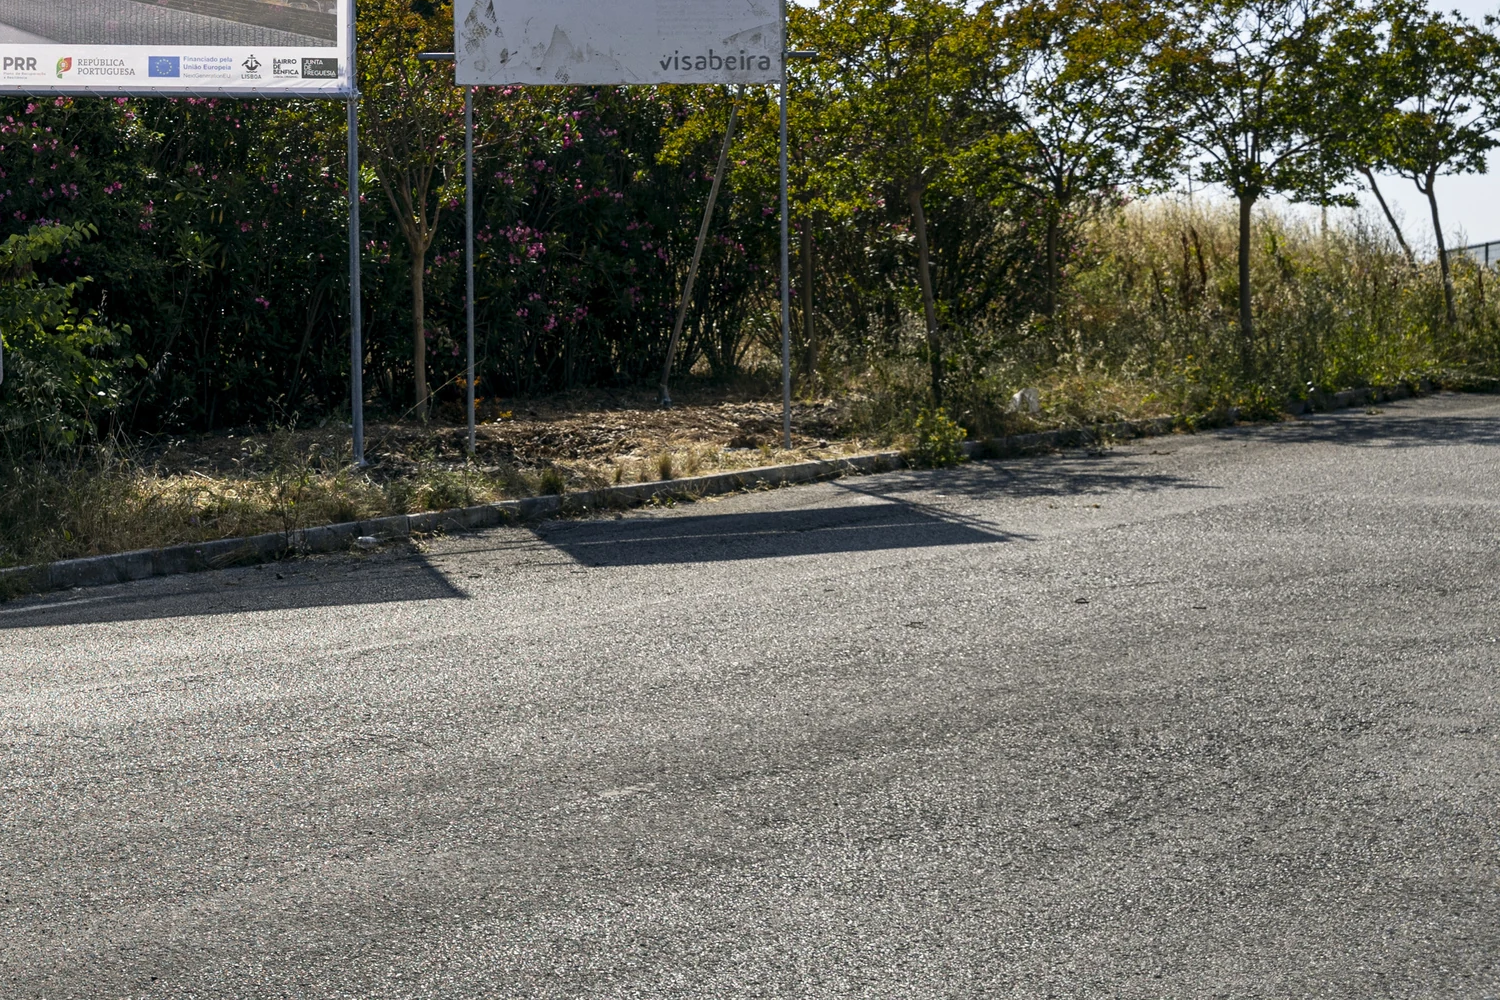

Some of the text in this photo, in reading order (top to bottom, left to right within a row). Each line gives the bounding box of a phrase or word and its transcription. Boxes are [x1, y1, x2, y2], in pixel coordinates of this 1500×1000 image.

[3, 57, 37, 70] PRR
[77, 57, 125, 67] REPÚBLICA
[660, 49, 771, 71] visabeira
[77, 67, 136, 76] PORTUGUESA
